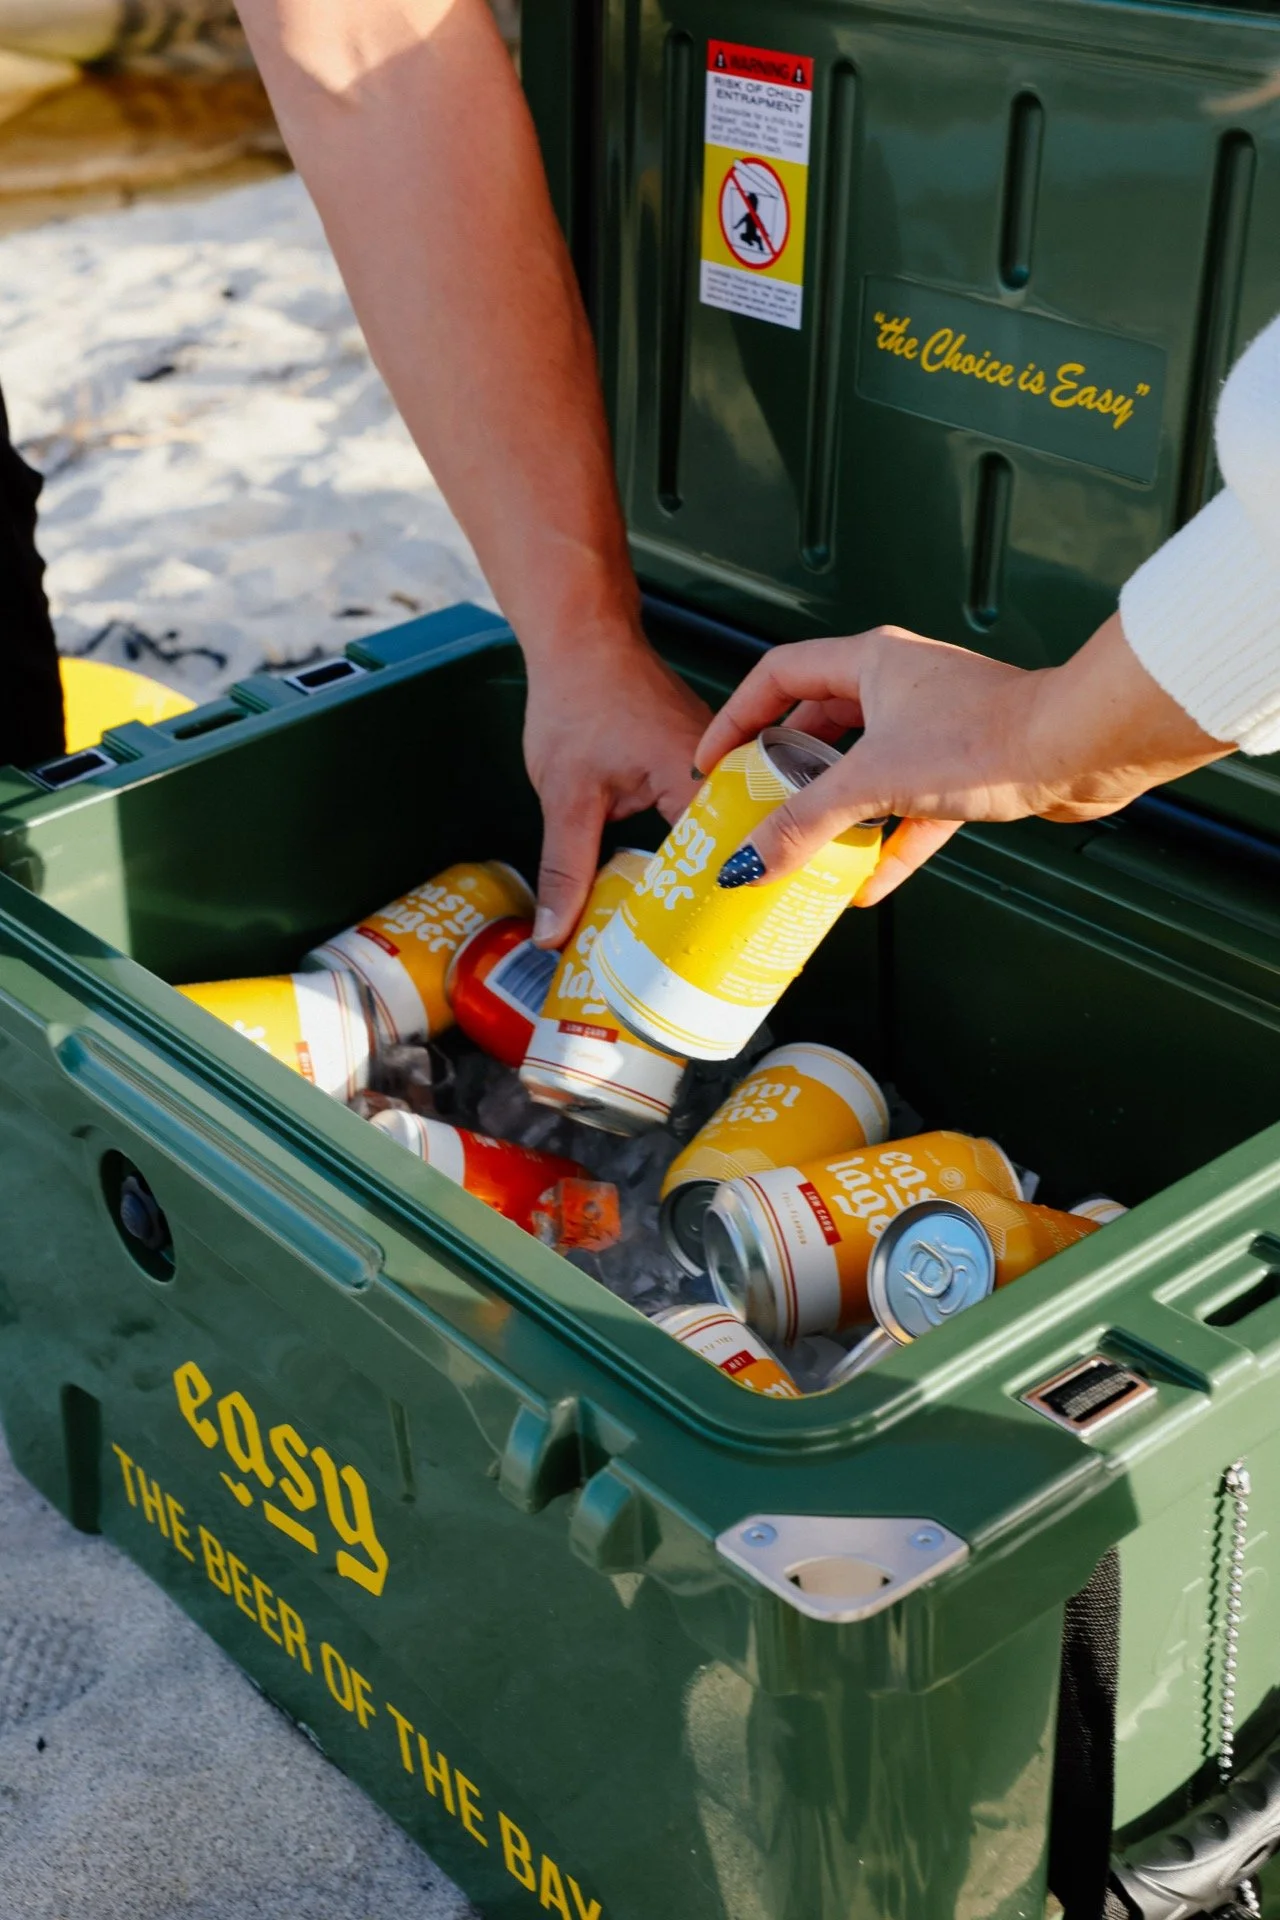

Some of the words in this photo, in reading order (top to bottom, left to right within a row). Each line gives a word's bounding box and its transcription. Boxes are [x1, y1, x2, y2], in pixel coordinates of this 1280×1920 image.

[714, 75, 742, 91] RISK
[746, 82, 763, 94] OF
[766, 86, 805, 104] CHILD
[730, 54, 790, 80] WARNING
[716, 88, 801, 115] ENTRAPMENT
[920, 327, 1015, 388] Choice
[1018, 363, 1046, 396] is
[825, 1156, 893, 1239] lage
[879, 1151, 938, 1204] eas
[805, 1191, 821, 1208] LOW
[816, 1209, 835, 1233] CARB
[173, 1361, 389, 1597] easy
[113, 1443, 195, 1562] THE
[199, 1525, 312, 1674] BEER
[320, 1642, 376, 1729] OF
[386, 1702, 489, 1847] THE
